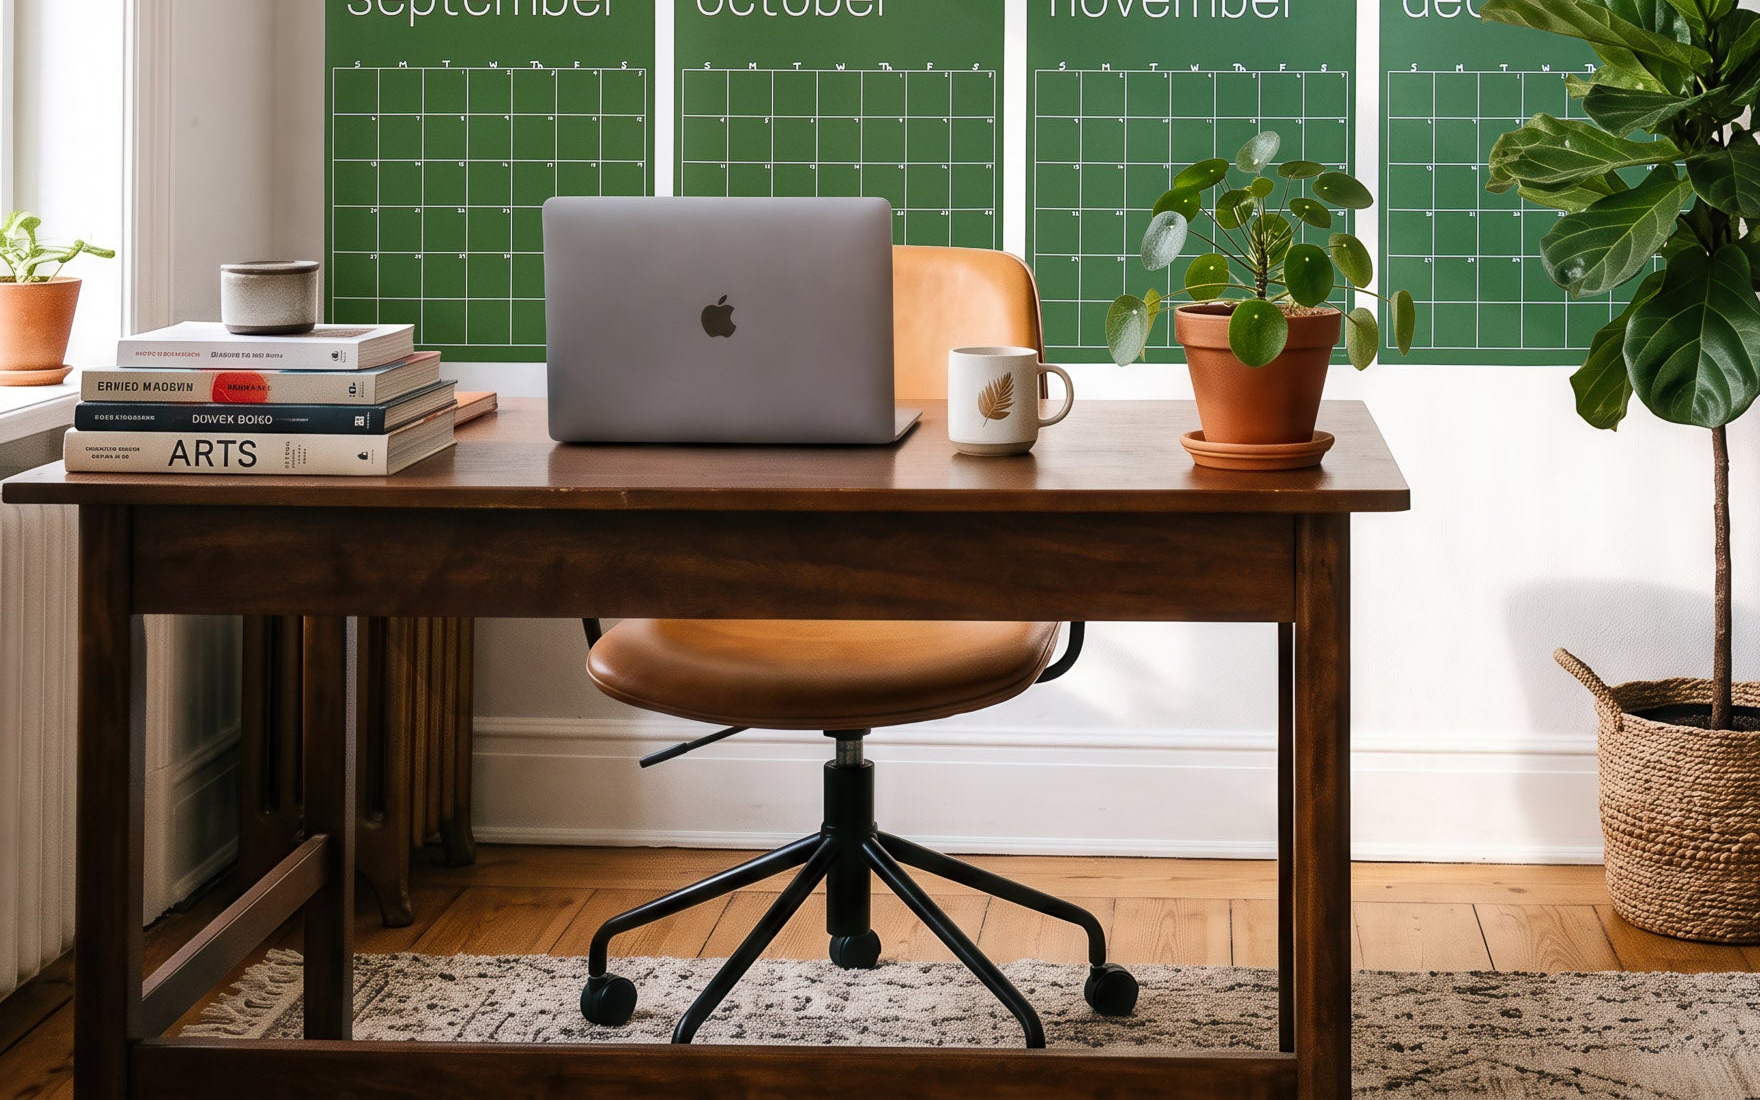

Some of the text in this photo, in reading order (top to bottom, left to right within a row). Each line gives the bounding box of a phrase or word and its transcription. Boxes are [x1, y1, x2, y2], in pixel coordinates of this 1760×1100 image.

[354, 59, 628, 68] S M T W Th F S
[703, 61, 980, 71] S M T W Th F S
[1058, 61, 1328, 72] S M T W Th F S
[1410, 62, 1418, 71] S
[1455, 63, 1464, 71] M
[1499, 63, 1508, 71] T
[168, 439, 258, 469] ARTS
